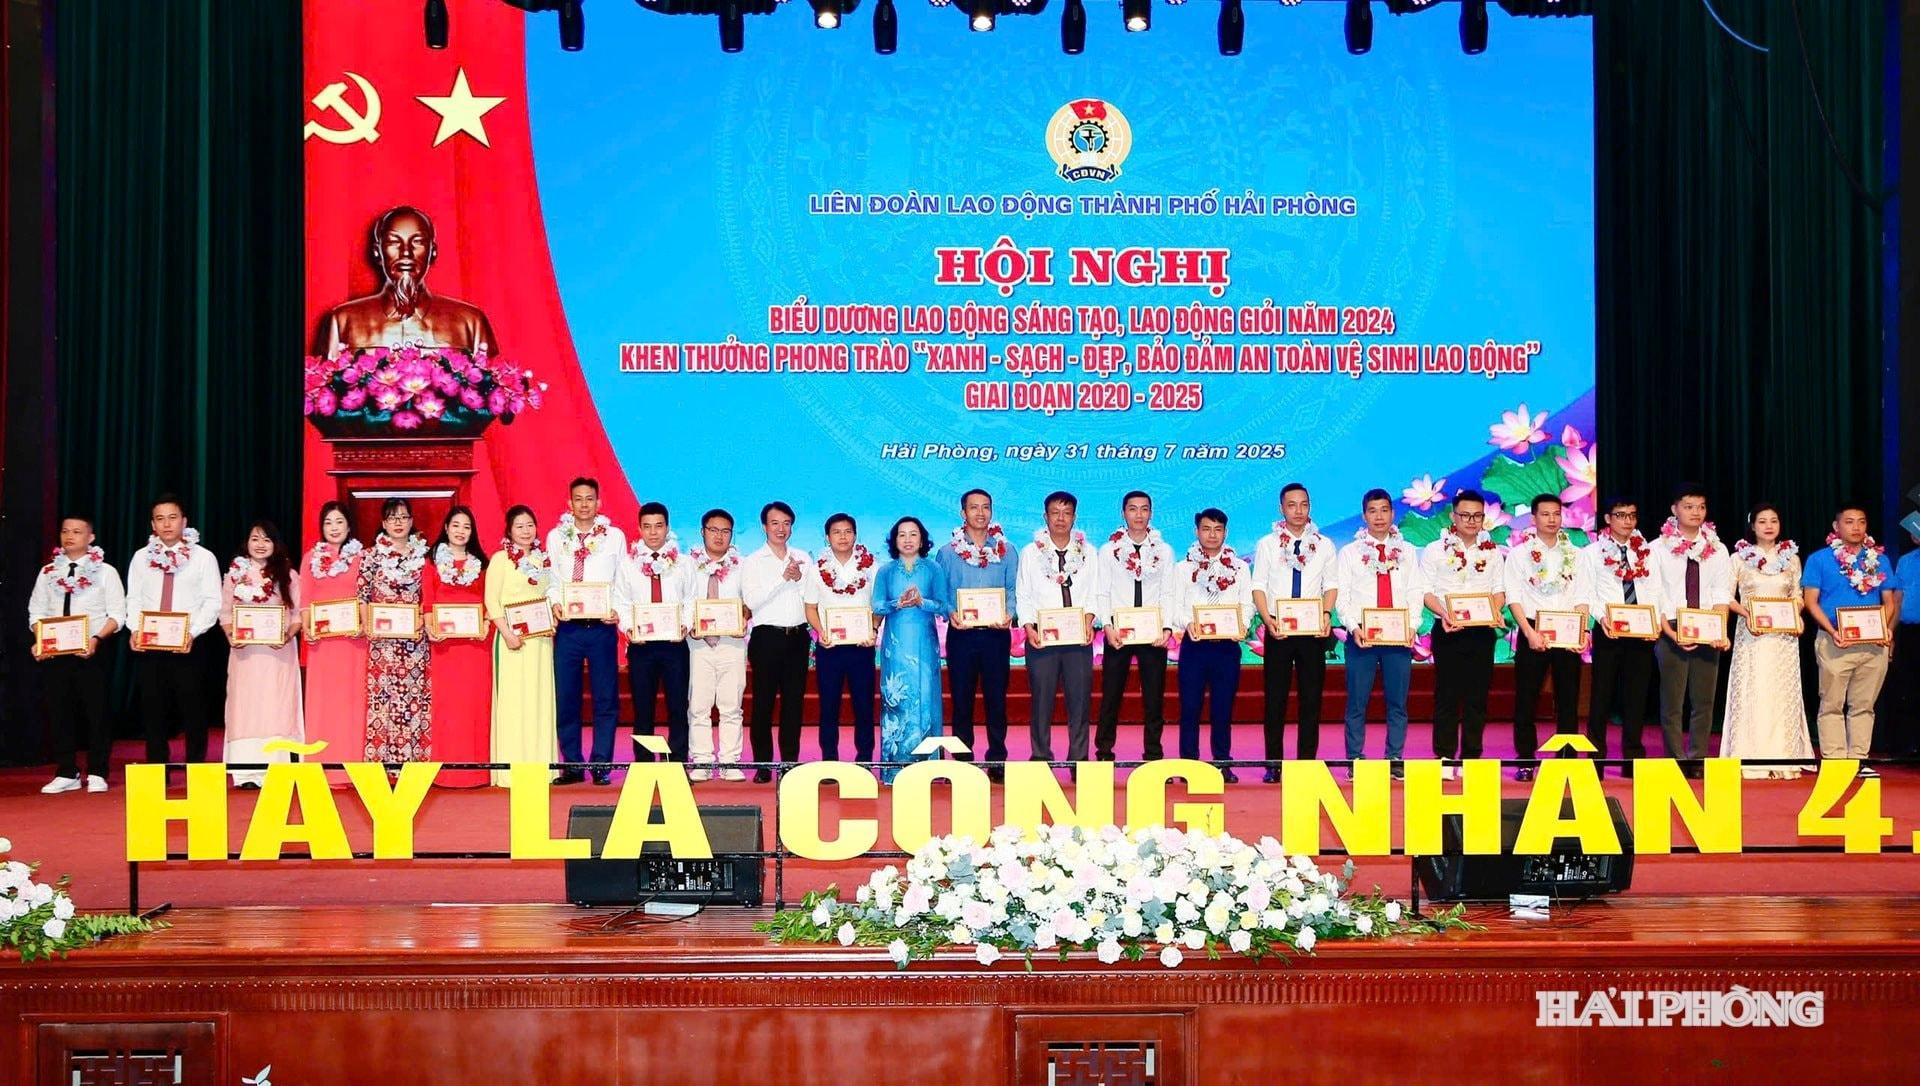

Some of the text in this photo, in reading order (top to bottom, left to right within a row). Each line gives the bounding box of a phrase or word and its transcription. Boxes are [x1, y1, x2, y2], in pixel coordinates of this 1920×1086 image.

[809, 187, 1356, 220] LIÊN ĐOÀN LAO ĐỘNG THÀNH PHỐ HẢI PHÒNG
[934, 235, 1230, 297] HỘI NGHỊ
[768, 295, 1395, 340] BIỂU DƯƠNG LAO ĐỘNG SÁNG TẠO, LAO ĐỘNG GIỎI NĂM 2024
[620, 343, 679, 372] KHEN
[682, 334, 770, 372] THƯỞNG
[773, 343, 849, 372] PHONG
[852, 337, 909, 372] TRÀO
[1004, 343, 1064, 378] SẠCH
[1081, 343, 1132, 378] ĐẸP,
[1135, 335, 1180, 372] BẢO
[1183, 335, 1234, 372] ĐẢM
[1237, 344, 1270, 373] AN
[1273, 339, 1331, 373] TOÀN
[1334, 339, 1362, 378] VỆ
[1366, 344, 1419, 373] SINH
[1422, 344, 1464, 373] LAO
[964, 381, 1009, 410] GIAI
[1012, 381, 1073, 416] ĐOẠN
[1076, 382, 1130, 410] 2020
[1148, 381, 1202, 410] 2025
[881, 442, 1286, 462] Hải Phòng, ngày 31 tháng 7 năm 2025
[125, 739, 442, 861] HÃY
[509, 735, 713, 861] LÀ
[779, 736, 1226, 861] CÔNG
[1282, 734, 1743, 856] NHÂN
